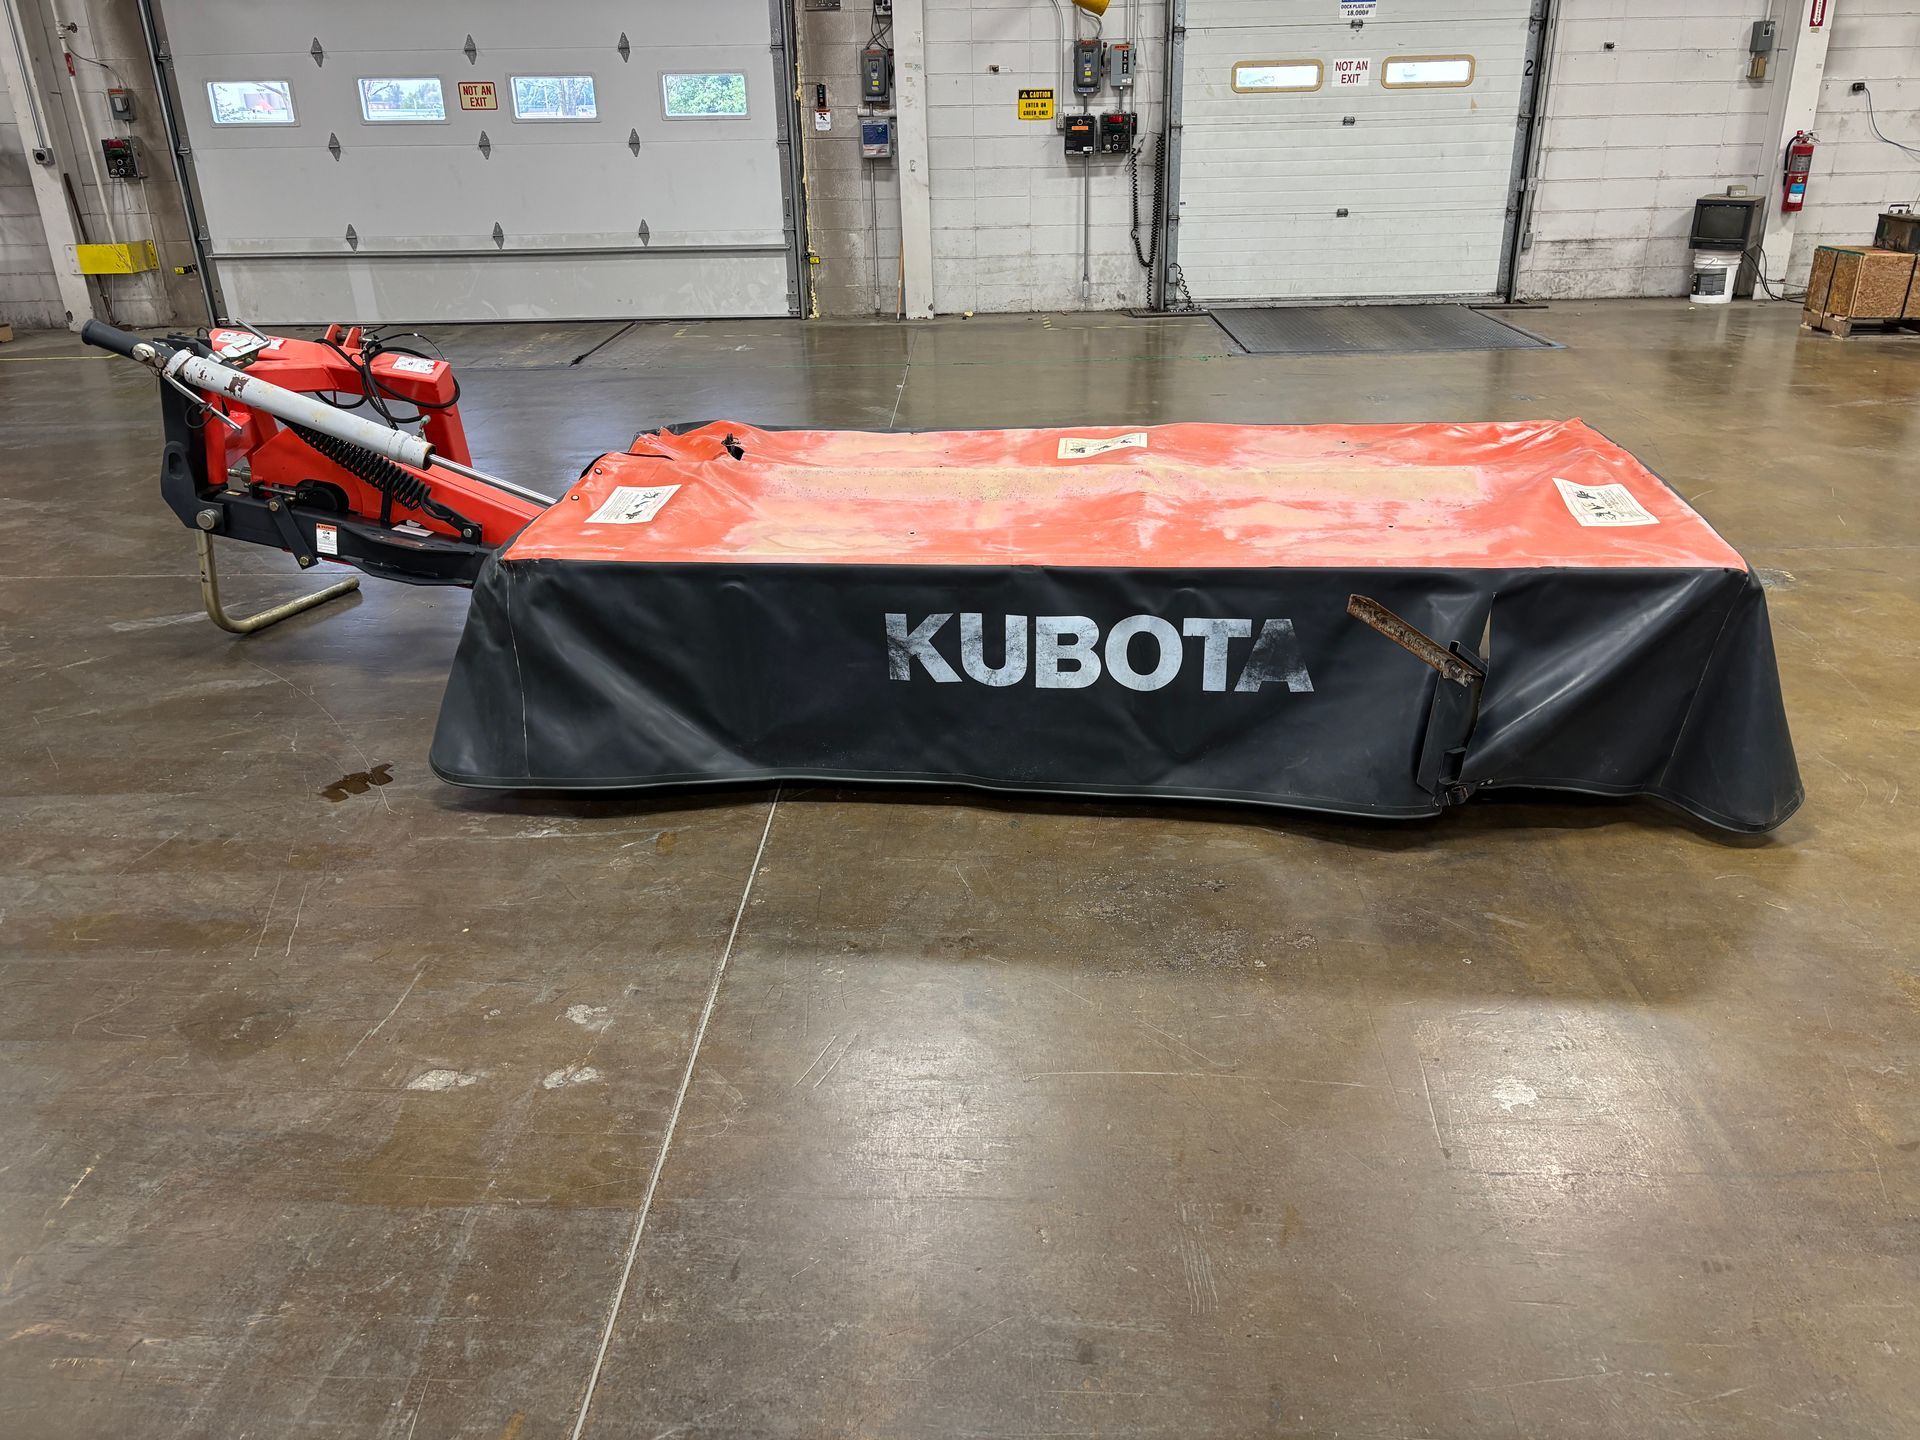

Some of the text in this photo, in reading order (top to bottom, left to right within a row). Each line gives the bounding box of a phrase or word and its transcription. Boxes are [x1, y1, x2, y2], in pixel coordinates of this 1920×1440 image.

[1335, 61, 1368, 71] NOT AN
[1525, 59, 1534, 76] 2
[1341, 74, 1360, 84] EXIT
[463, 85, 492, 96] NOT AN
[470, 97, 487, 107] EXIT
[884, 612, 1315, 693] KUBOTA
